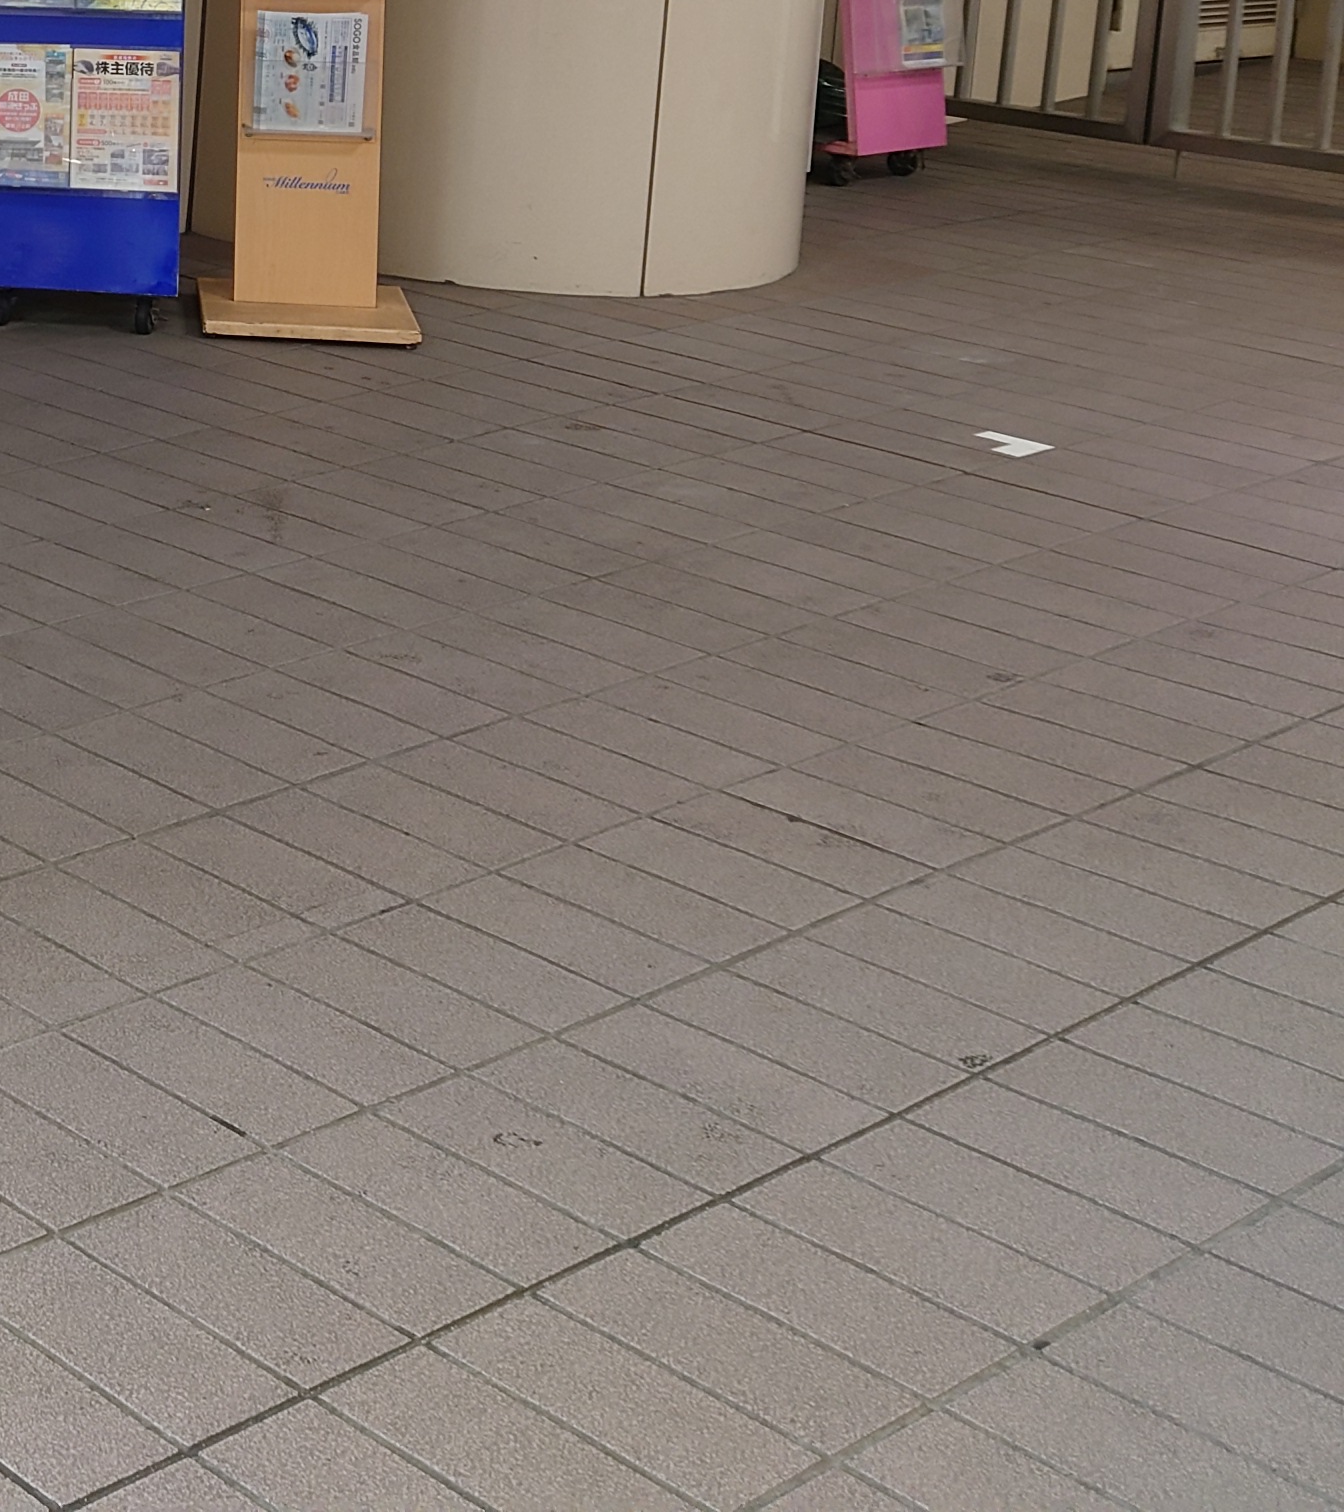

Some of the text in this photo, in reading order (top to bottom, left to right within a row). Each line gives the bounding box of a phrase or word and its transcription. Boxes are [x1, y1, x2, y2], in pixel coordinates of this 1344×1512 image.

[96, 60, 155, 77] 株主優待
[270, 168, 351, 191] Millennium
